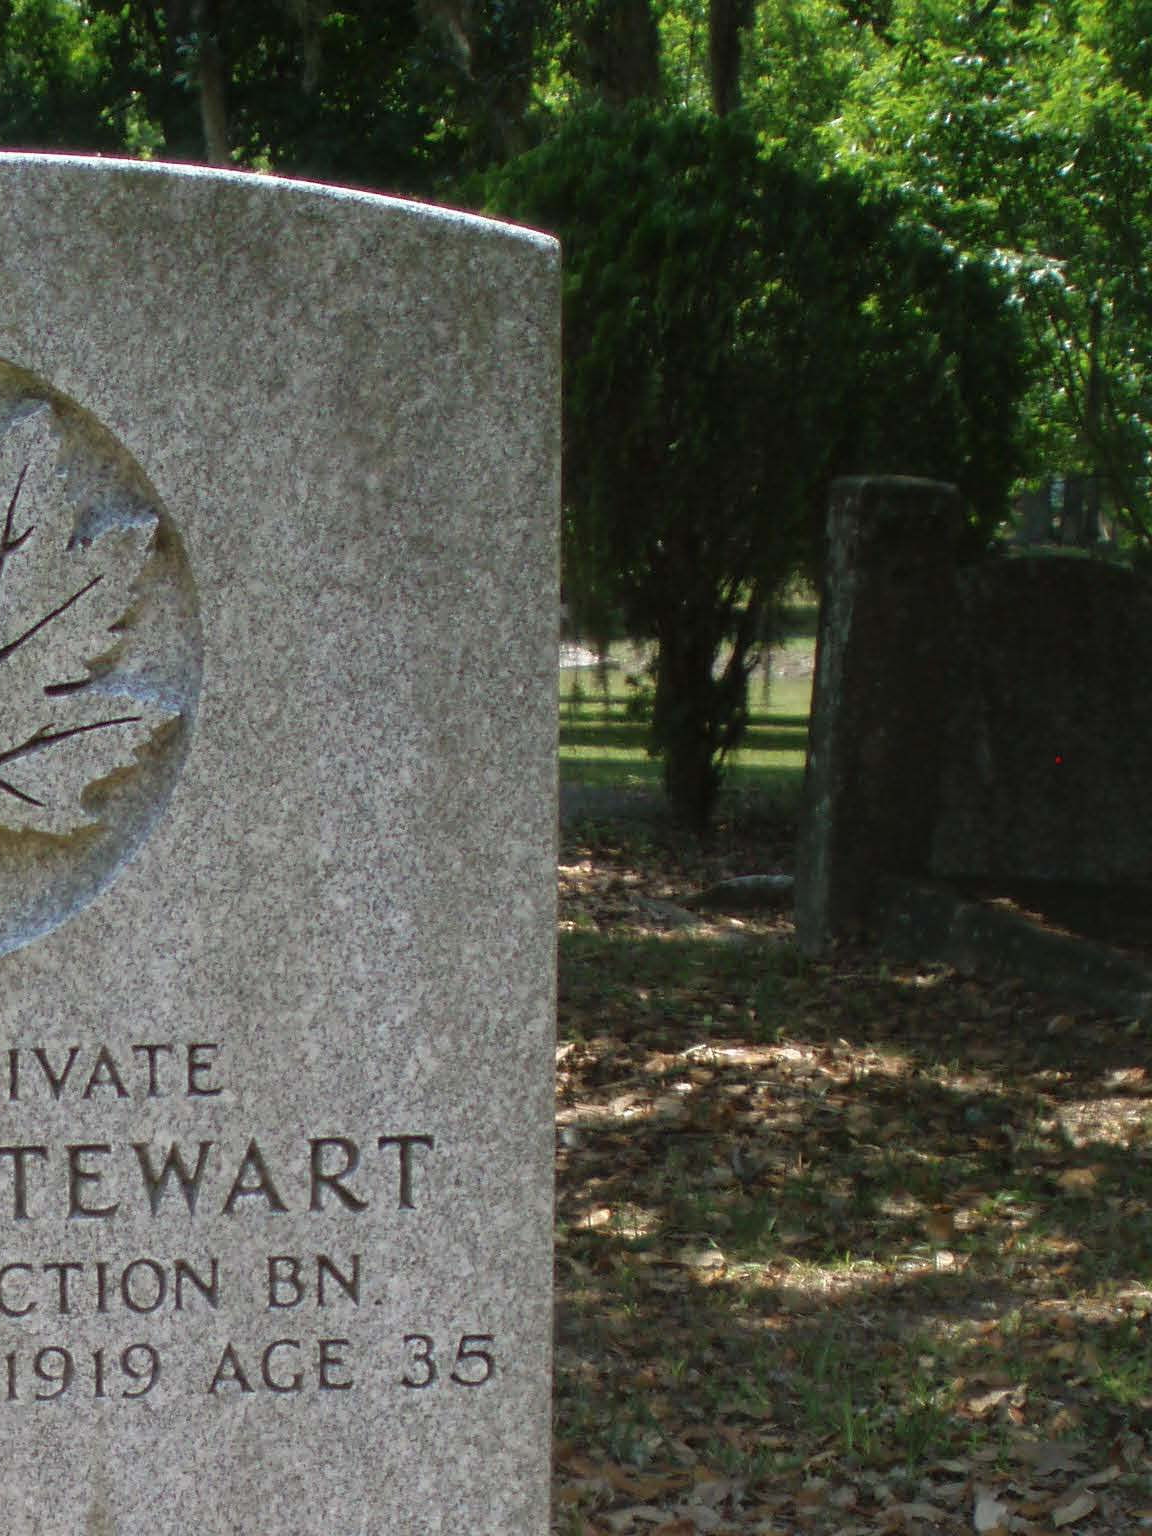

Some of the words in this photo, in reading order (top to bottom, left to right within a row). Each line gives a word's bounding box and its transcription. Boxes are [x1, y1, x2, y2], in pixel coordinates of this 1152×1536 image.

[5, 1343, 162, 1401] 1919
[207, 1337, 354, 1396] AGE
[400, 1333, 496, 1390] 35
